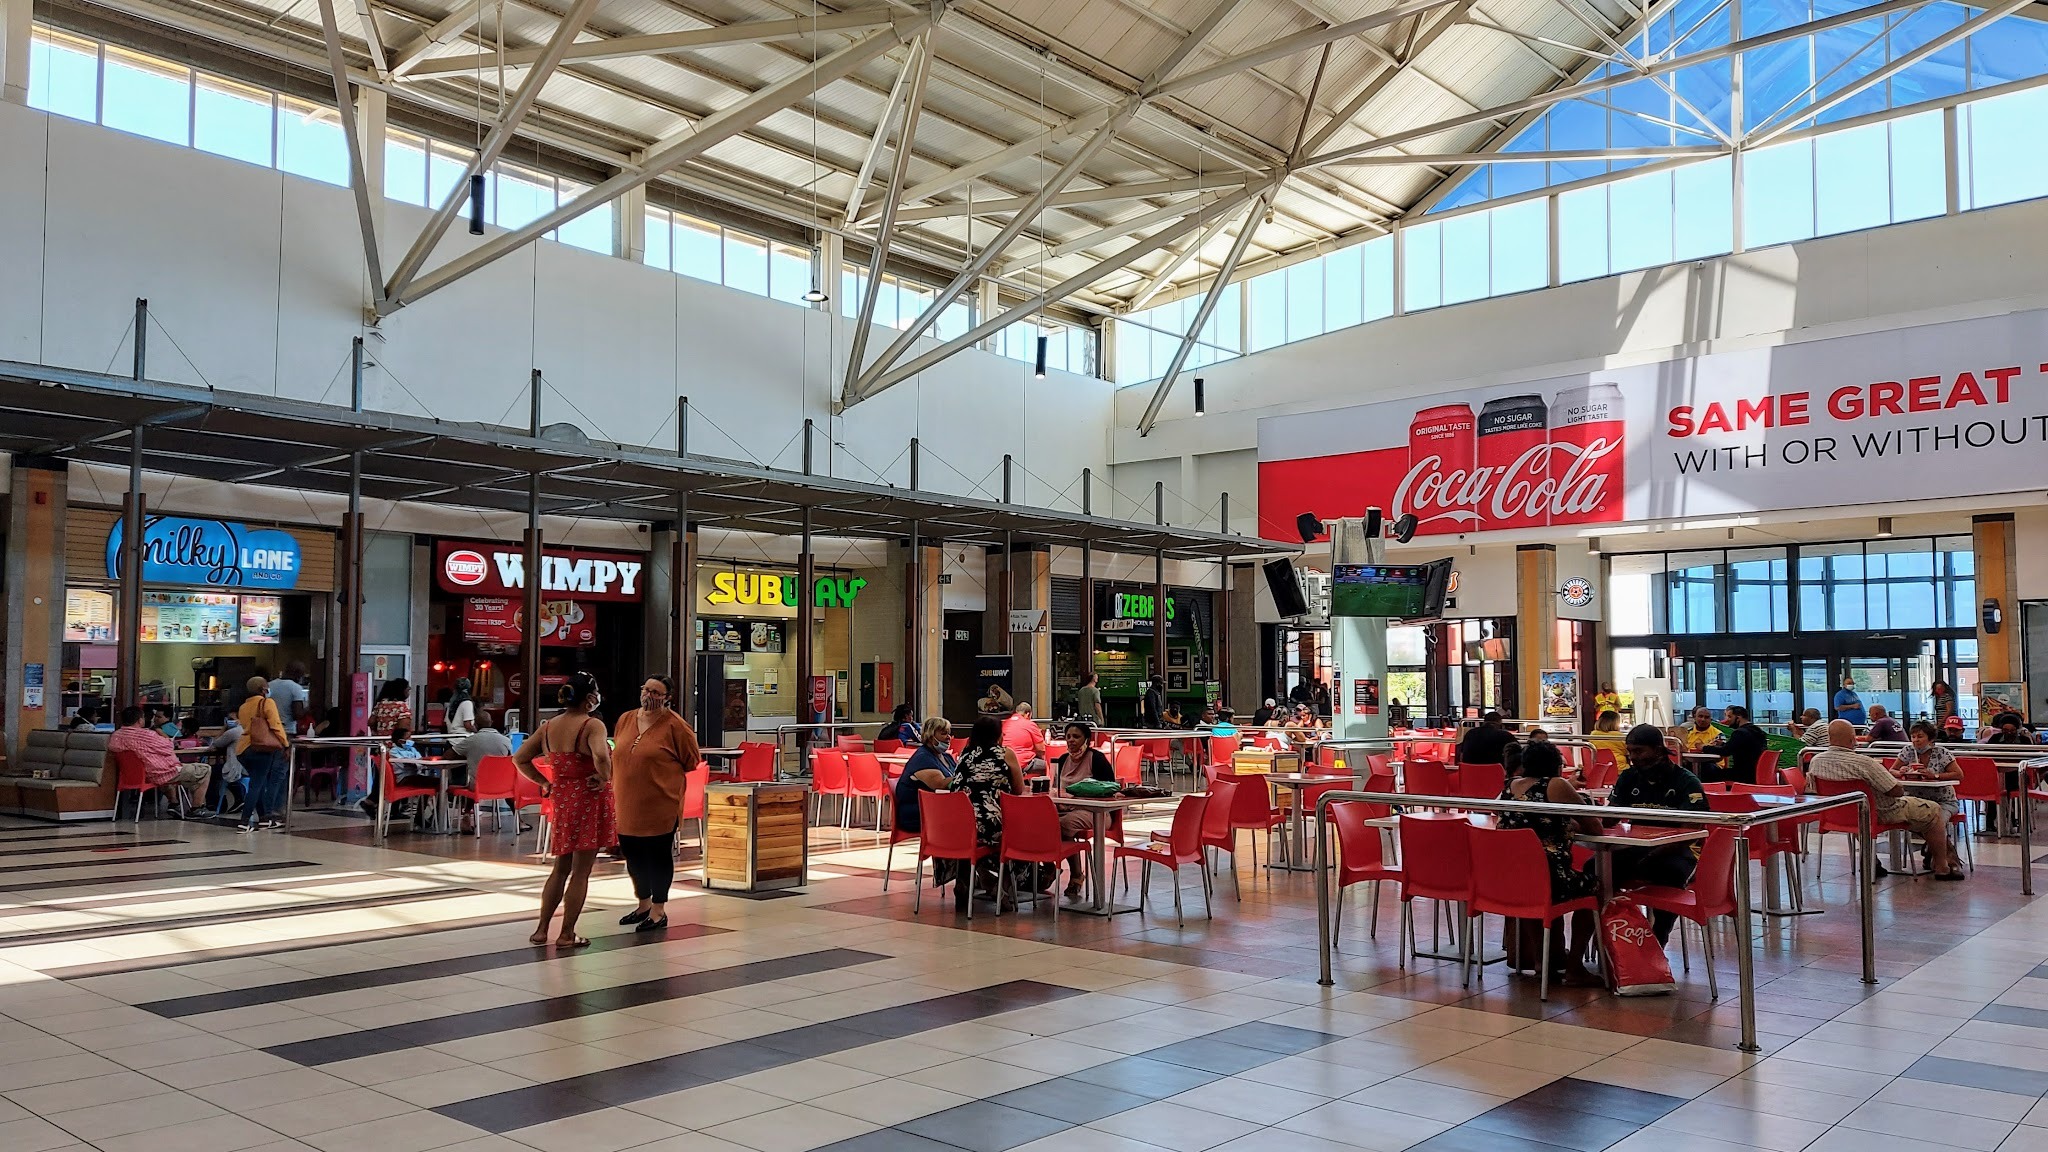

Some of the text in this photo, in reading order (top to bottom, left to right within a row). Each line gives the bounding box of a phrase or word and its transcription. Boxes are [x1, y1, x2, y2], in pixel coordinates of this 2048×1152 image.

[1567, 403, 1608, 415] NO SUGAR
[1667, 366, 2022, 438] SAME GREAT
[1494, 413, 1533, 425] NO SUGAR
[1567, 415, 1586, 423] LIGHT
[1415, 422, 1471, 436] ORIGINAL TASTE
[1674, 415, 2048, 474] WITH OR WITHOUT
[1392, 434, 1624, 522] Coca-Cola
[241, 548, 295, 571] LANE
[448, 562, 484, 574] WIMPY
[493, 552, 642, 595] WIMPY
[470, 597, 509, 605] Celebrating
[980, 669, 1010, 677] SUBWAY
[1605, 918, 1654, 947] Rage
